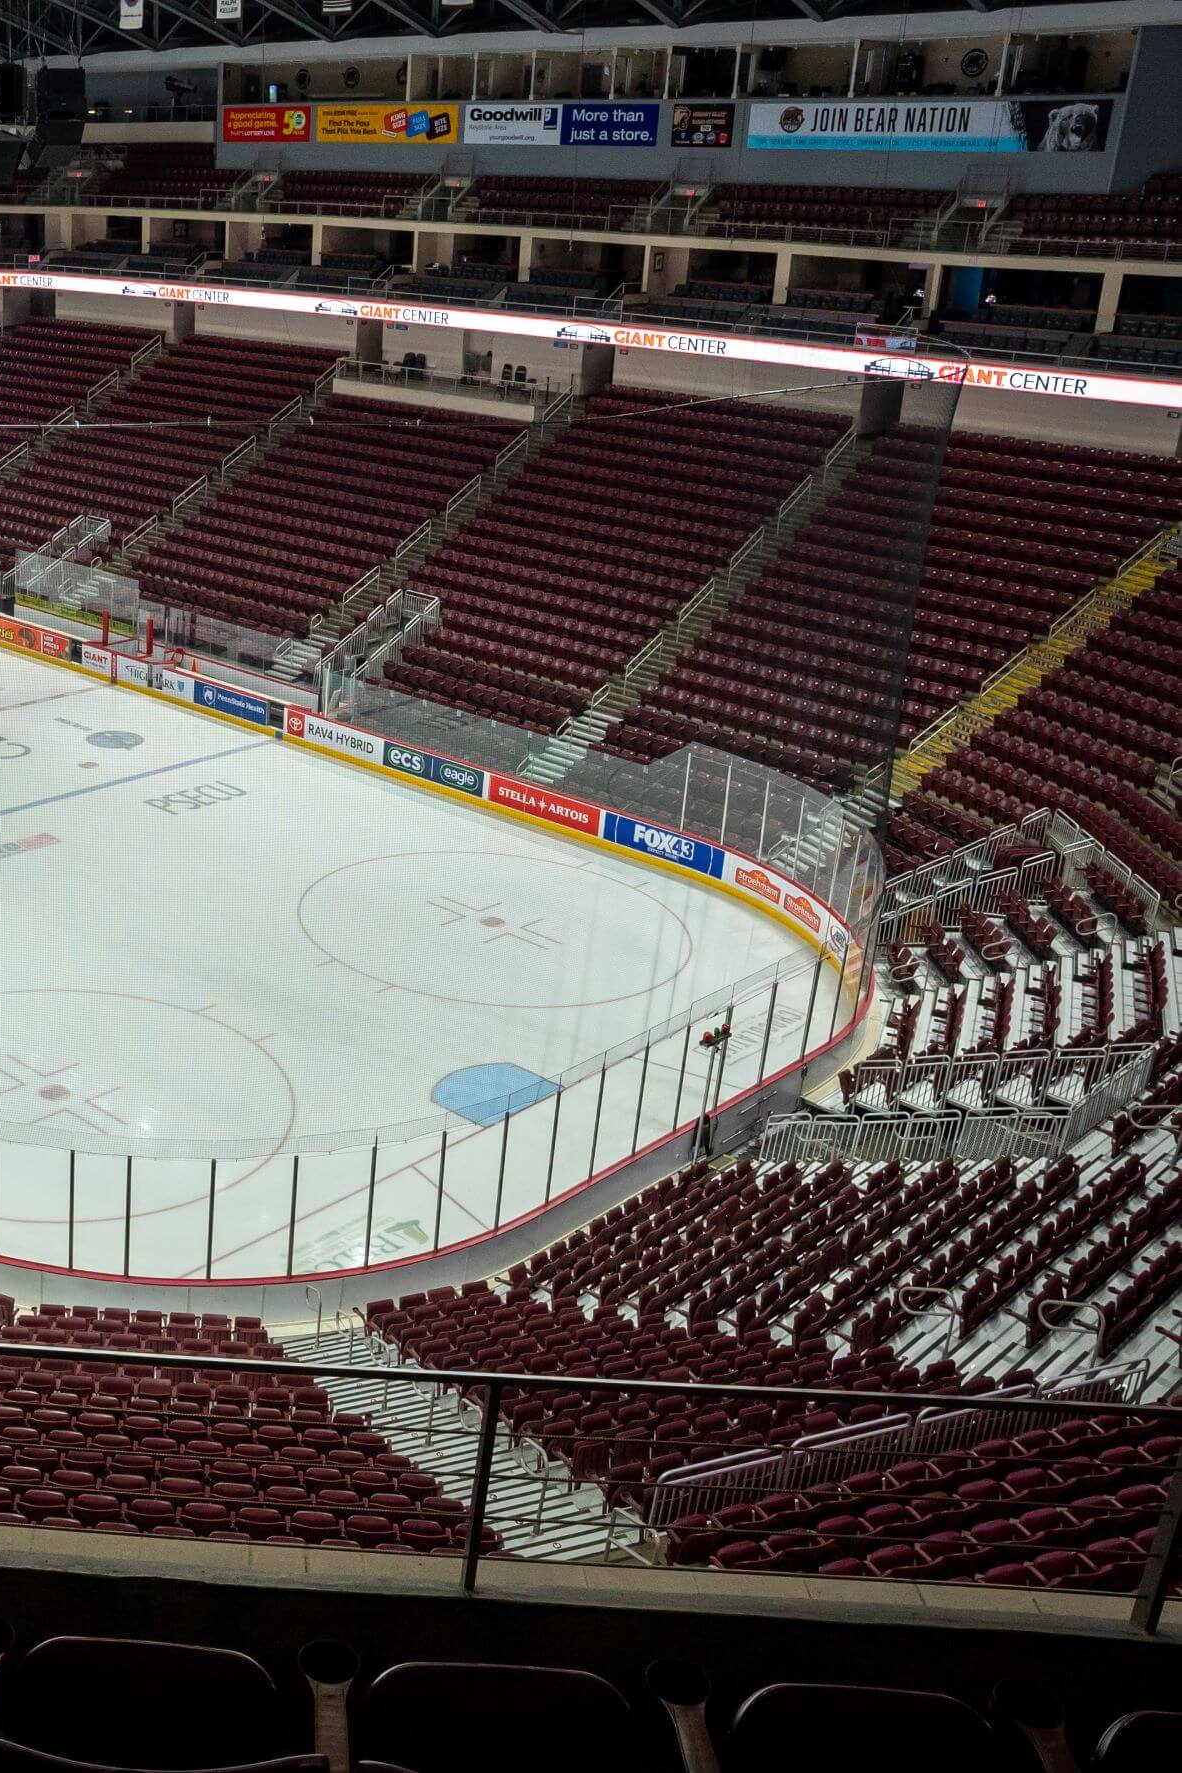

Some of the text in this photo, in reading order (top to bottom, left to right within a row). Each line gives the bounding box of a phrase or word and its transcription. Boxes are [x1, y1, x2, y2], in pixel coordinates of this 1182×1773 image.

[229, 111, 277, 121] Appreciating
[390, 111, 406, 123] KING
[411, 114, 427, 125] FULL
[470, 108, 542, 122] Goodwill
[572, 108, 645, 123] More than
[810, 107, 972, 133] JOIN BEAR NATION
[232, 119, 254, 130] good
[254, 119, 279, 130] game.
[329, 119, 344, 127] Find
[344, 119, 355, 127] The
[392, 119, 406, 130] SIZE
[414, 121, 427, 131] SIZE
[435, 124, 449, 135] SIZE
[489, 134, 535, 142] yourgoodwill.org
[569, 129, 654, 143] just a store.
[19, 275, 54, 289] CENTER
[158, 286, 230, 304] GIANT CENTER
[359, 305, 450, 326] GIANT CENTER
[613, 330, 727, 355] GIANT CENTER
[937, 364, 1090, 396] GIANT CENTER
[83, 650, 109, 665] GIANT
[217, 692, 265, 716] PennState Health
[308, 722, 375, 755] RAV4 HYBRID
[389, 748, 422, 771] ecs
[443, 765, 475, 787] eagle
[142, 779, 248, 816] PSECU
[498, 786, 590, 825] STELLA ARTOIS
[738, 870, 779, 898] Stroehmann
[786, 895, 820, 928] Stroehmann
